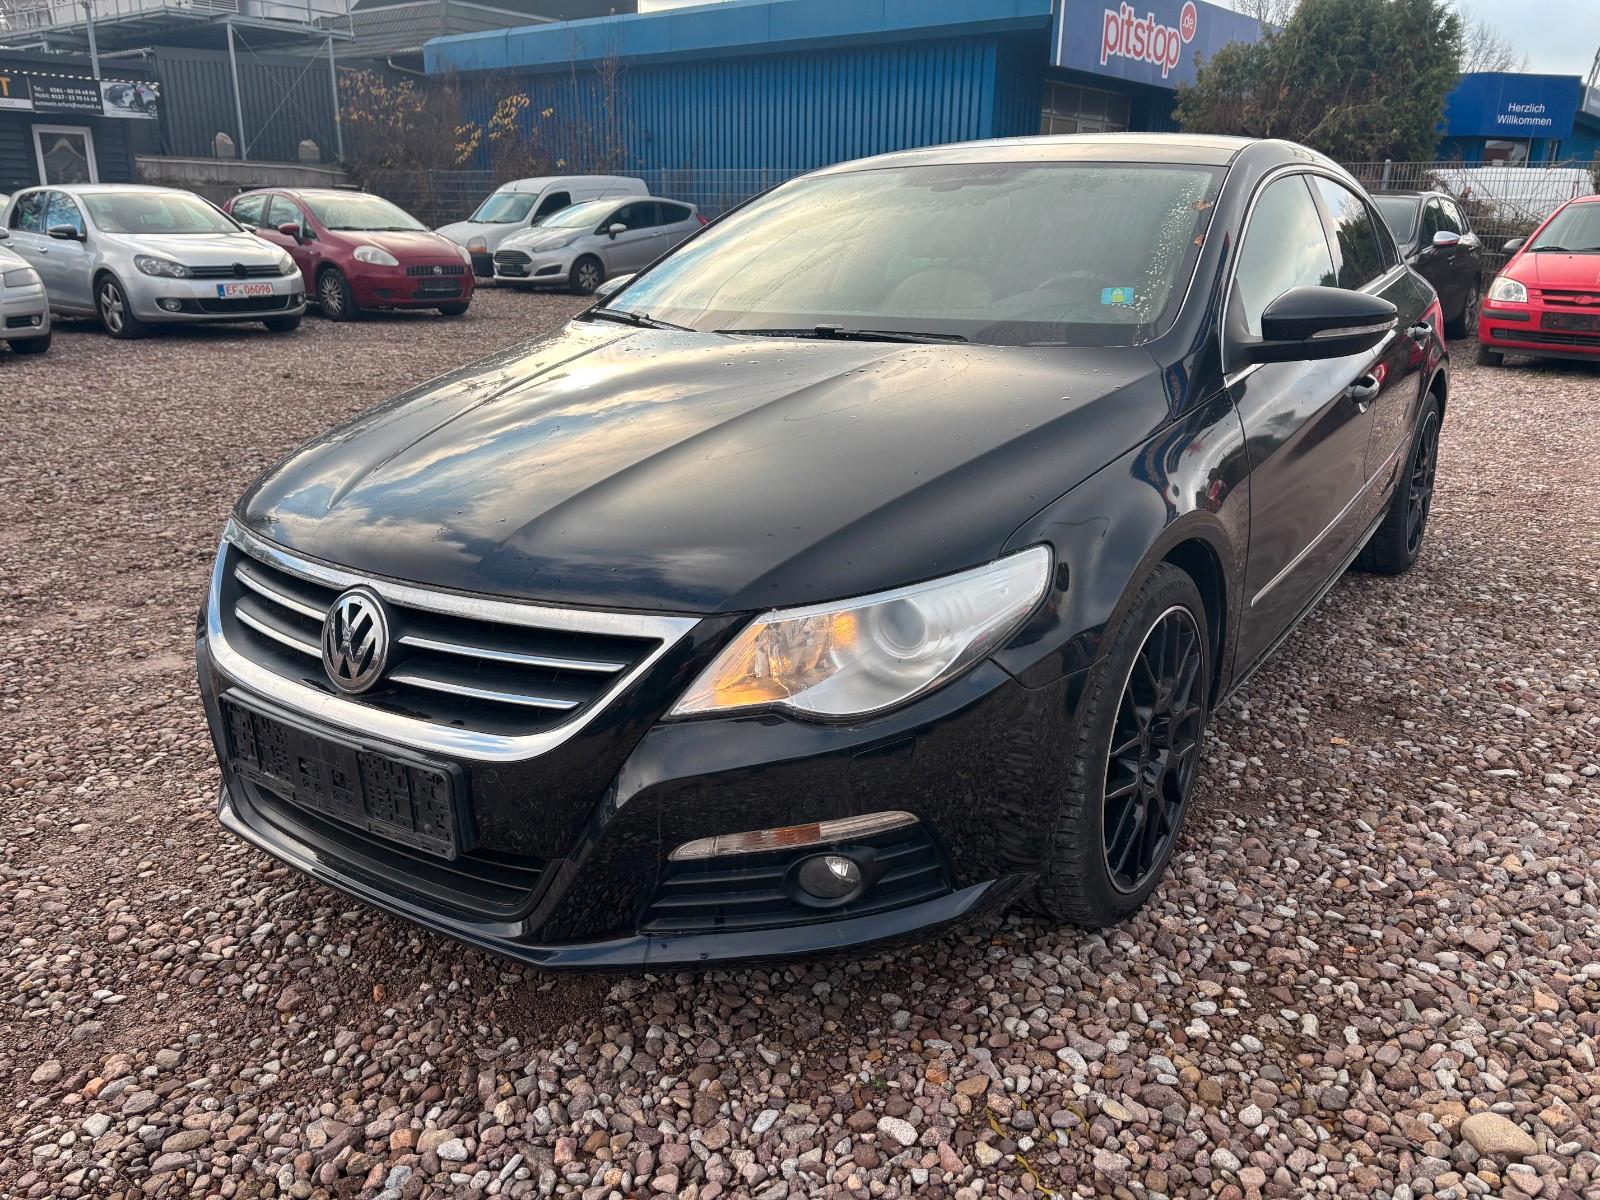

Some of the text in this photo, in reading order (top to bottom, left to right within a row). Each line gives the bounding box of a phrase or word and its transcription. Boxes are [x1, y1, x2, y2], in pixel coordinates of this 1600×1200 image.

[1100, 1, 1181, 79] pitstop
[1508, 102, 1545, 113] Herzlich
[1497, 114, 1552, 126] Willkommen
